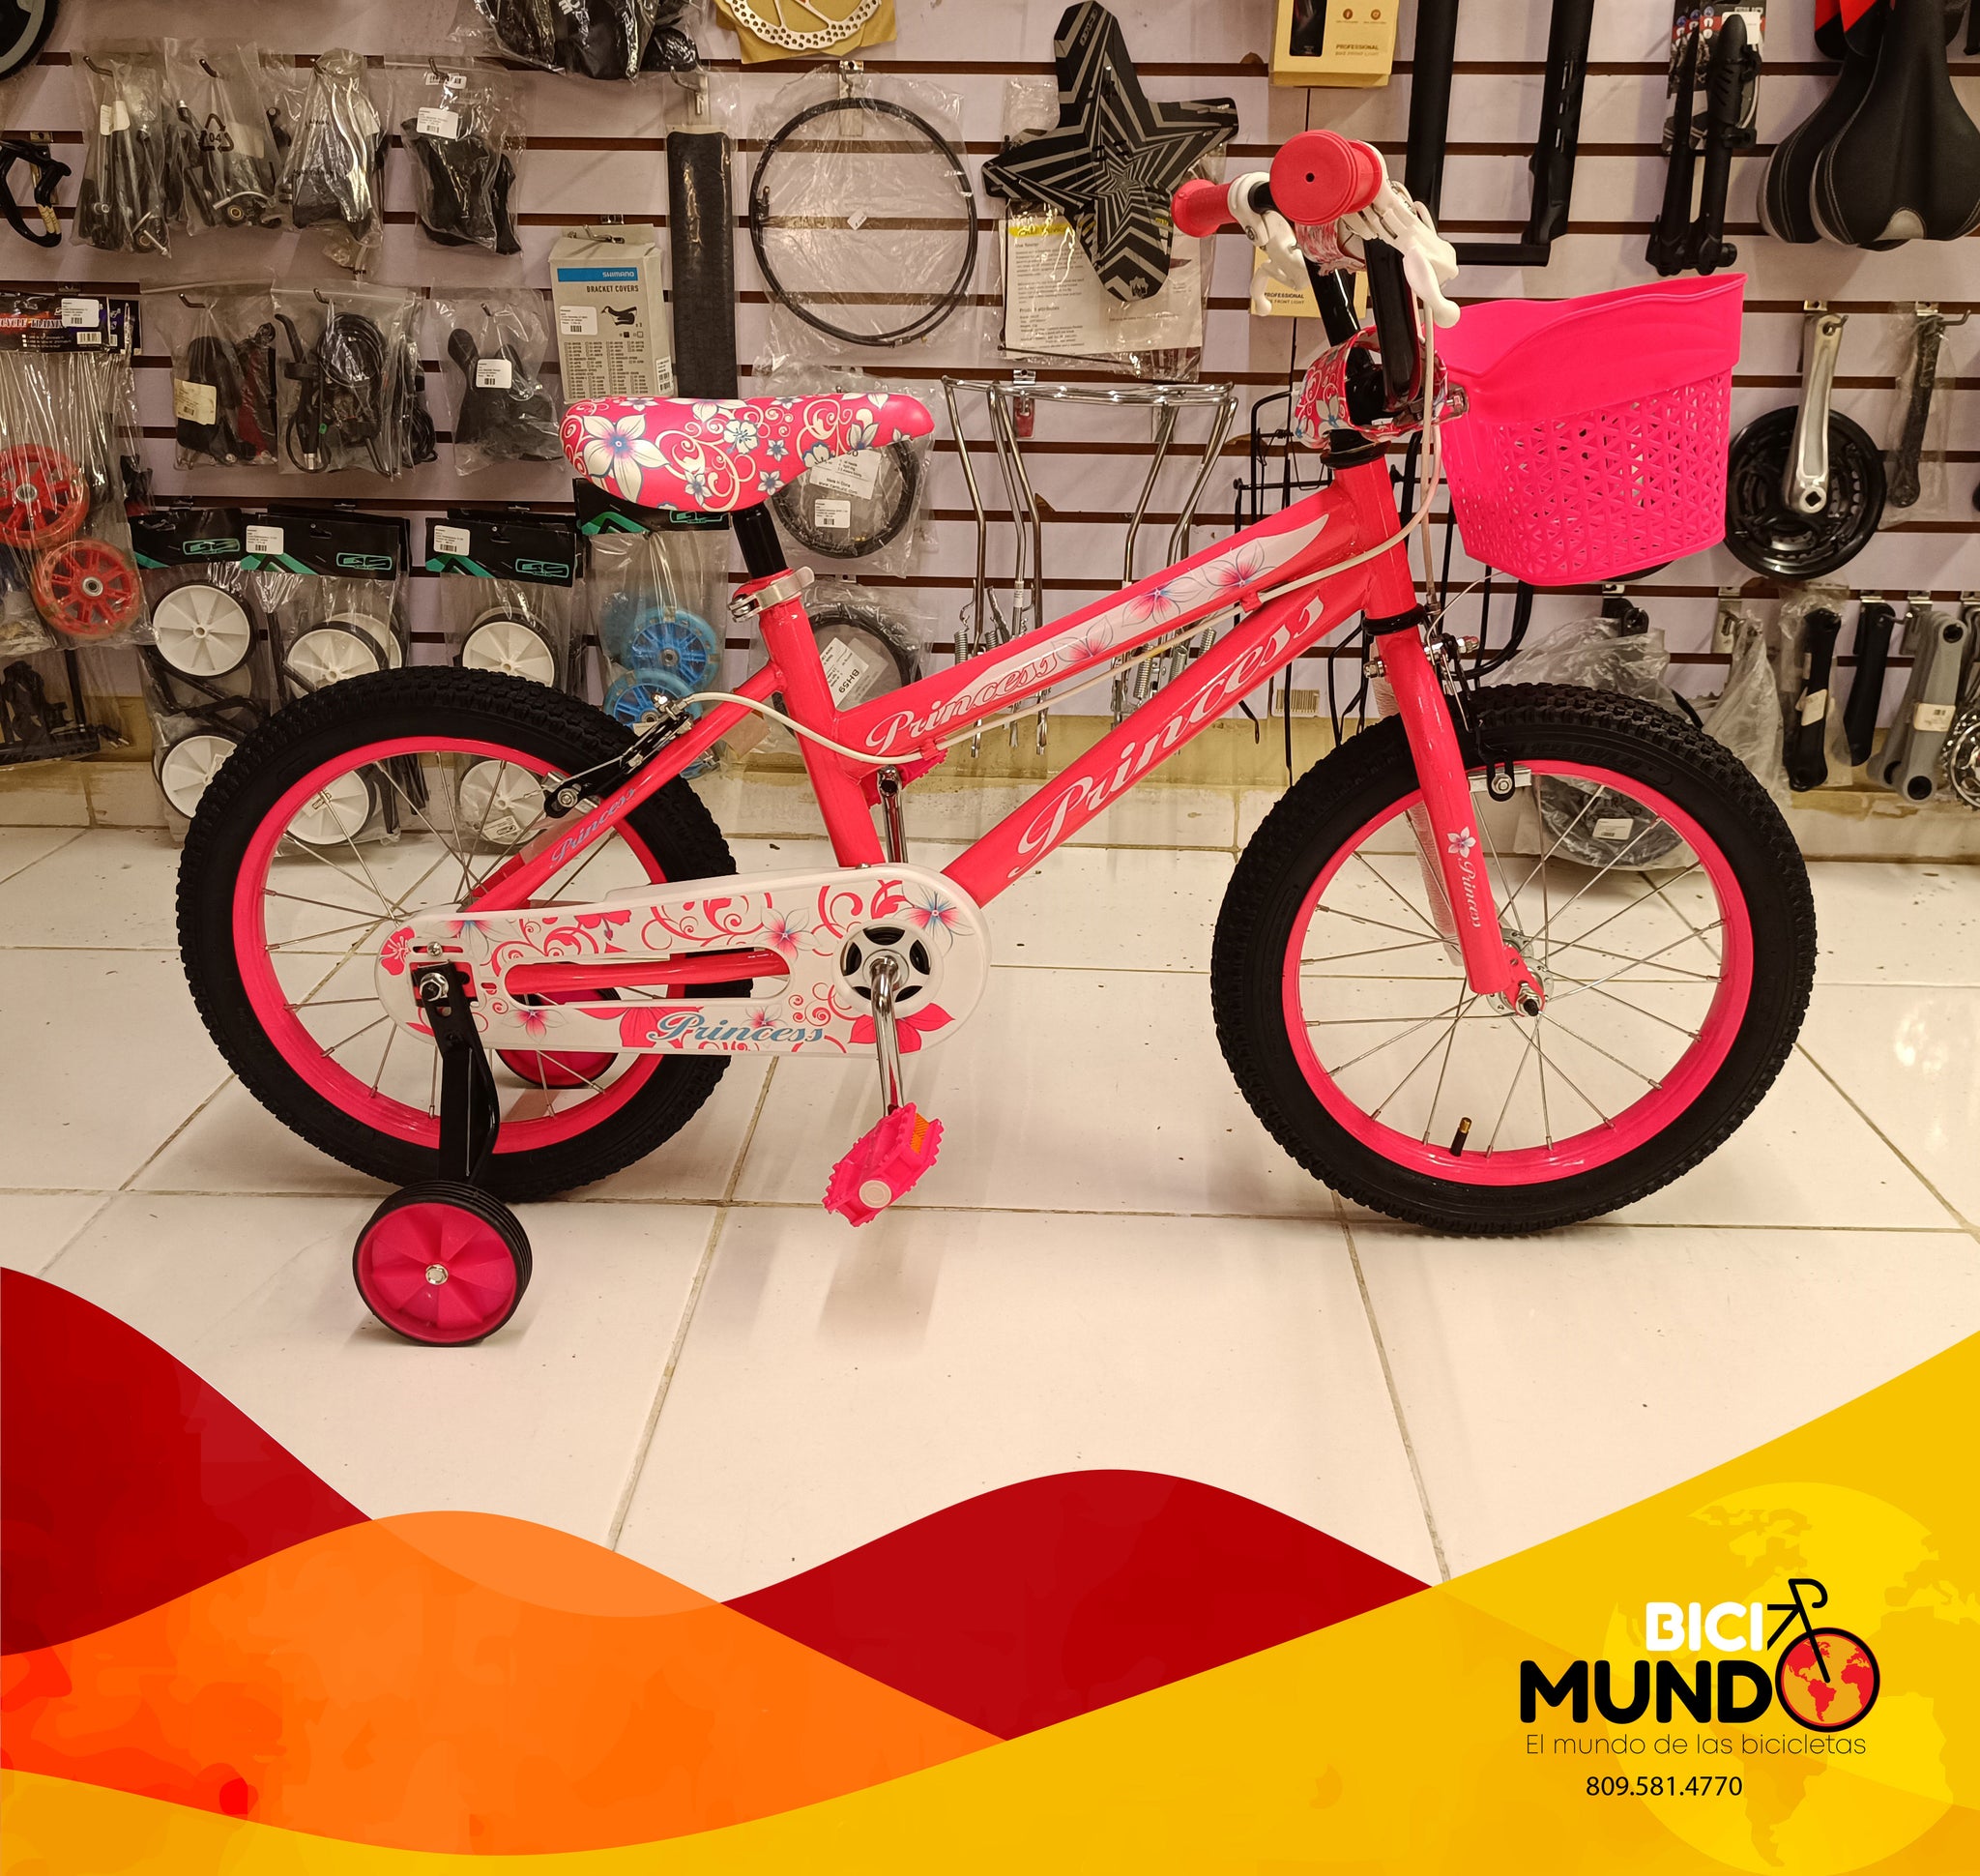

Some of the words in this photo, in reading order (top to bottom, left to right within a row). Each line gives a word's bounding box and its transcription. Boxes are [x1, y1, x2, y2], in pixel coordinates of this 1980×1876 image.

[615, 284, 639, 293] COVERS
[838, 668, 860, 693] BH59
[865, 651, 1058, 756] Princess
[1007, 592, 1325, 879] Princess
[549, 788, 635, 869] Princess
[1457, 858, 1481, 928] Princess
[647, 1012, 824, 1042] Princess
